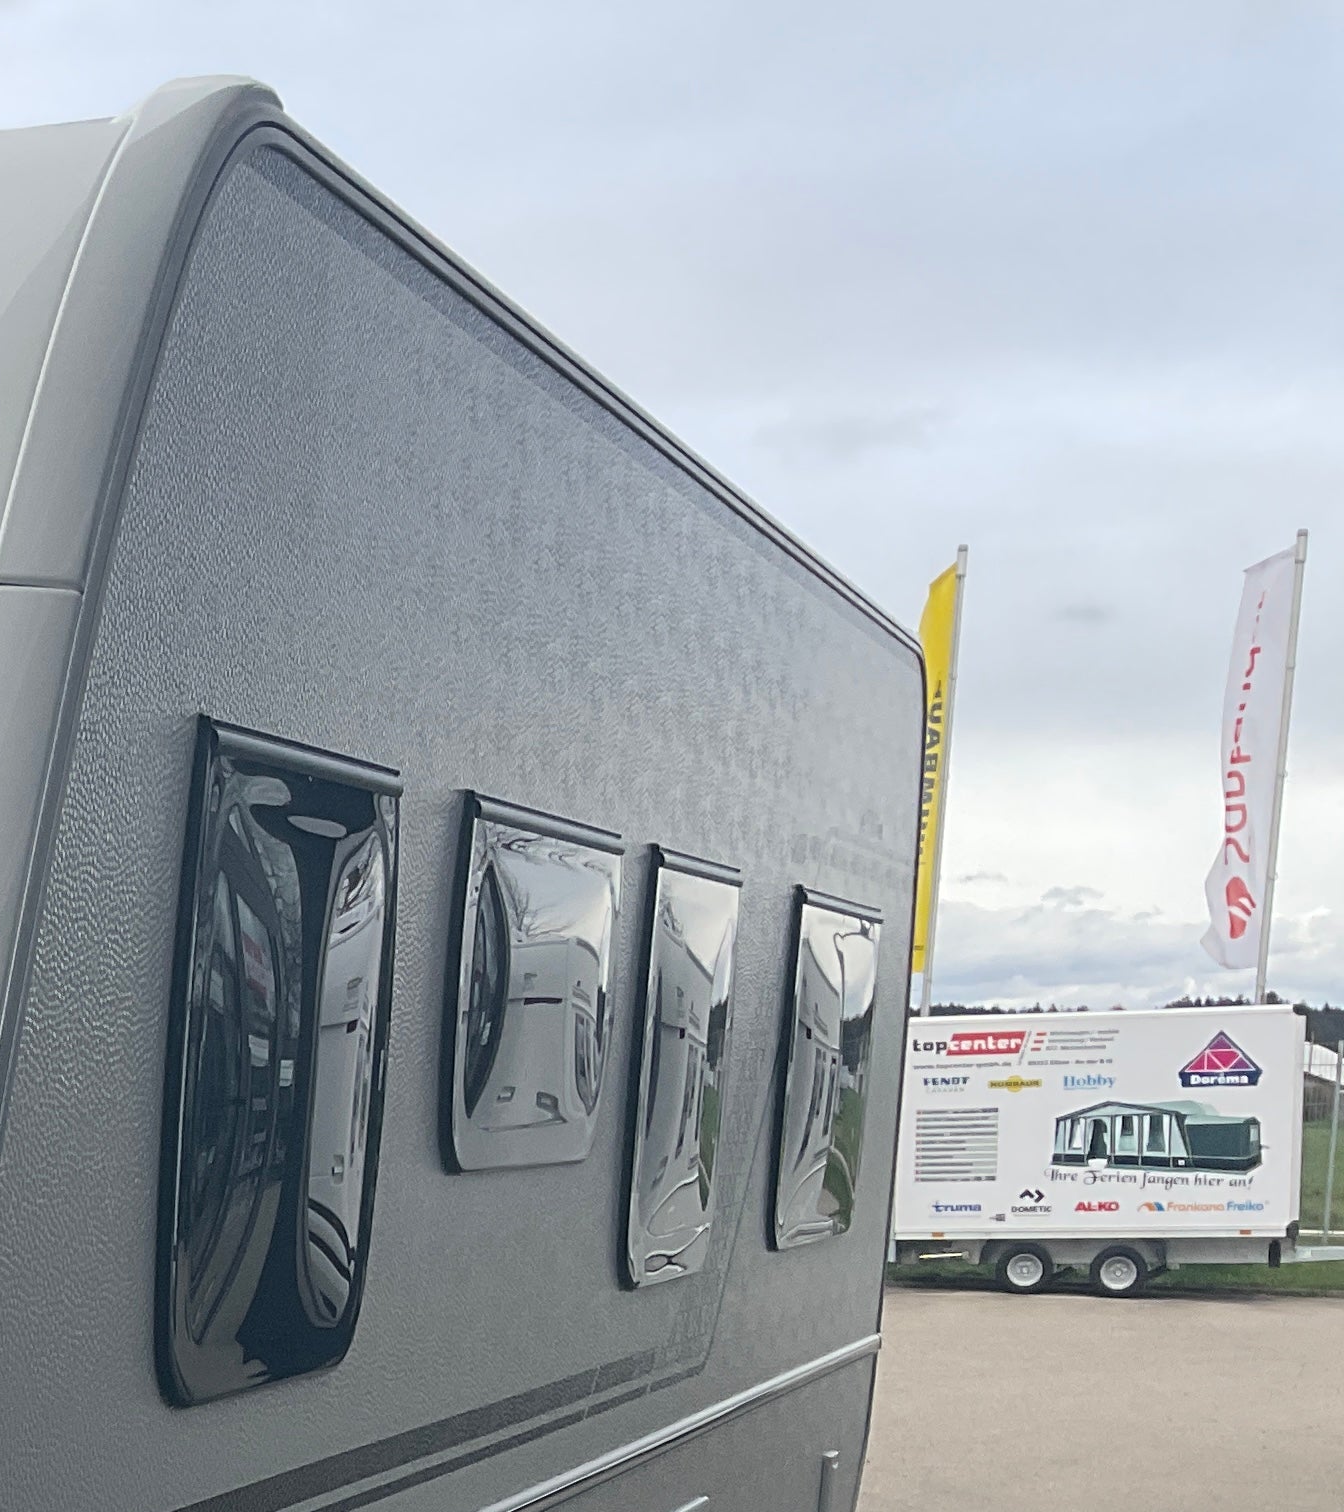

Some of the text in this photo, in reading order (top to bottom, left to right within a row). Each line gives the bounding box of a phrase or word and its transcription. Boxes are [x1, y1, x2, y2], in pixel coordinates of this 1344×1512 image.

[923, 1076, 970, 1086] FENDT
[1063, 1074, 1116, 1088] Hobby
[1044, 1168, 1078, 1181] Ihre
[1083, 1169, 1137, 1186] Ferien
[1193, 1173, 1224, 1186] hier
[931, 1200, 981, 1213] truma
[1167, 1201, 1264, 1212] Frankana Freiko
